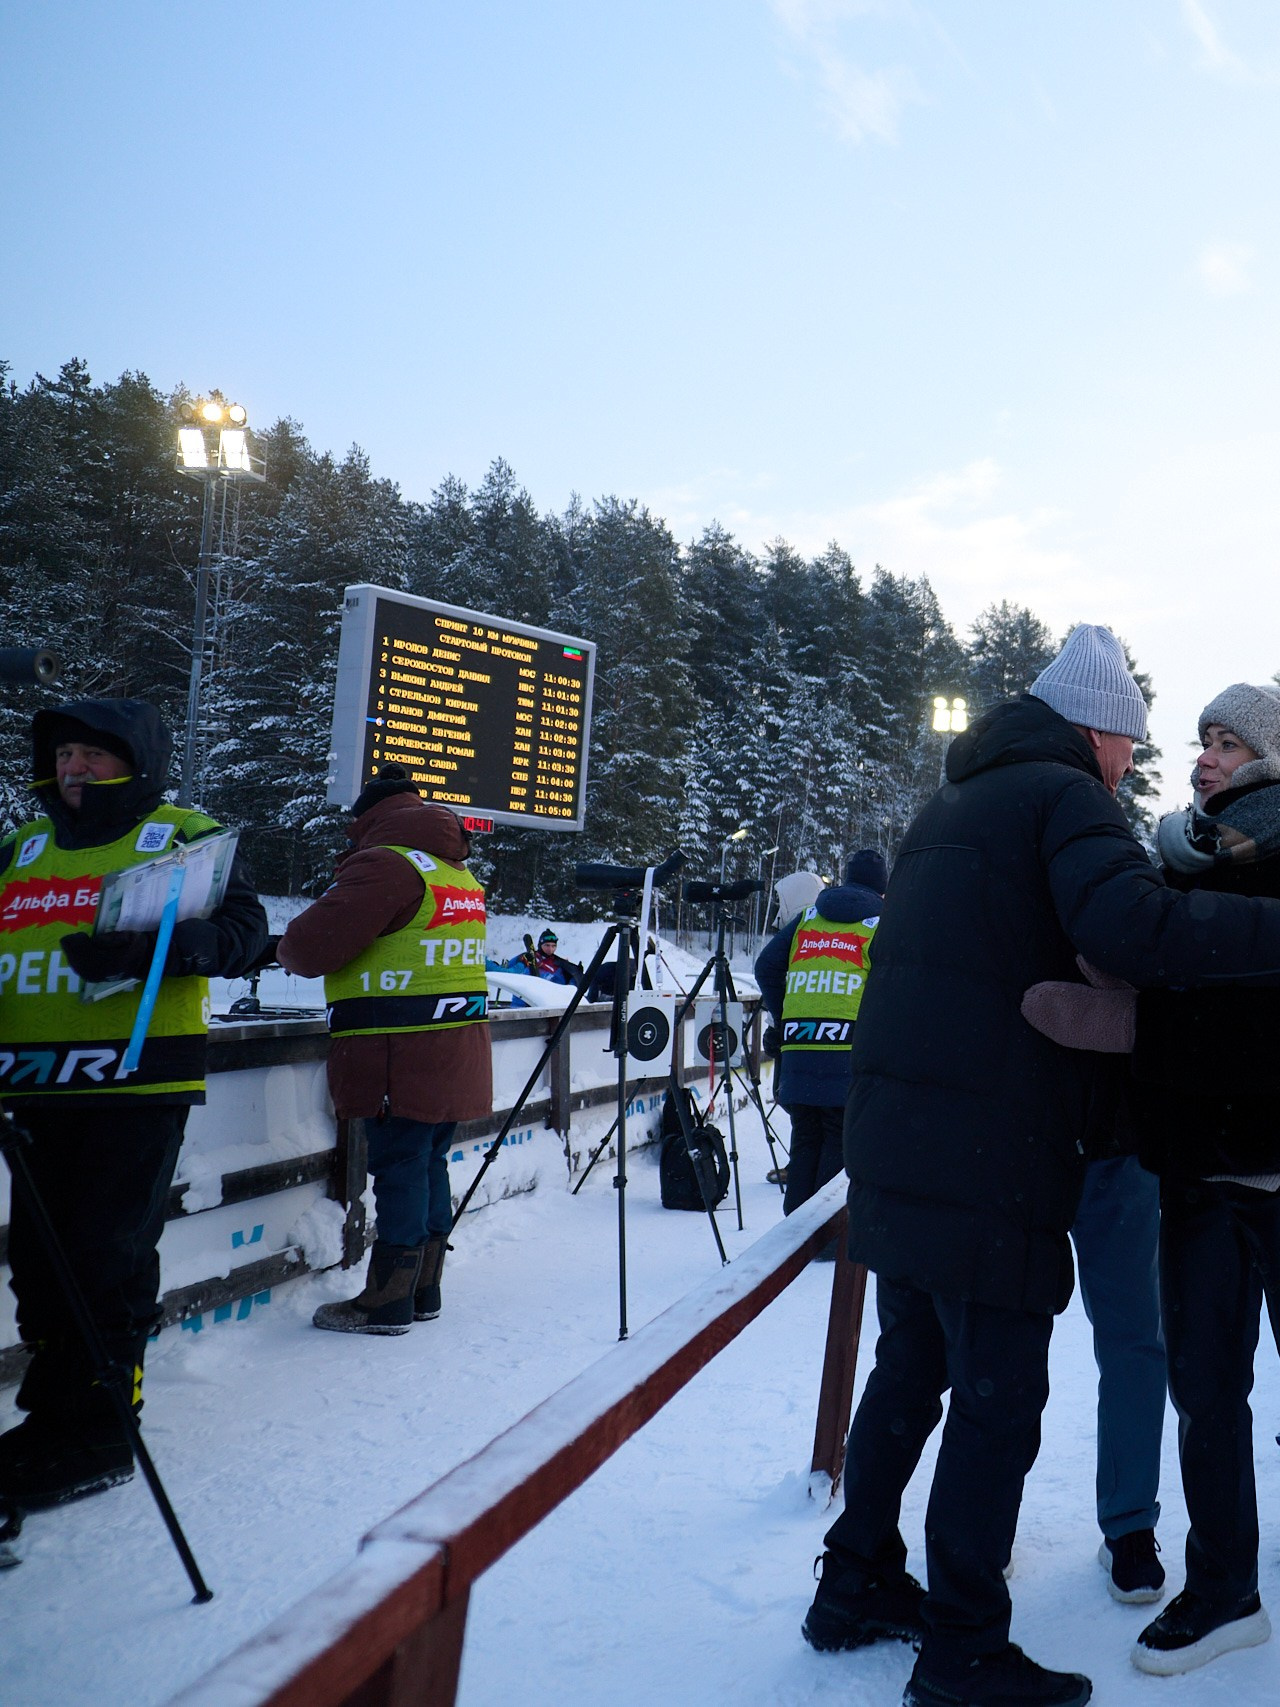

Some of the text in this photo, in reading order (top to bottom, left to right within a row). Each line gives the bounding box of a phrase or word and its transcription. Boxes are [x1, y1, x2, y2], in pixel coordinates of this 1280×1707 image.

[435, 618, 538, 650] СПРИНТ 10 КМ МУЖЧИНЫ
[439, 634, 532, 663] СТАРТОВЫЙ ПРОТОКОЛ
[381, 652, 388, 662] 2
[392, 655, 454, 676] СЕРОХВОСТОВ
[458, 669, 491, 684] ДАНИИЛ
[542, 687, 580, 703] 11:01:00
[383, 636, 581, 689] 1 ИРОДОВ ДЕНИС МОС 11:00:30
[379, 668, 386, 678] 3
[430, 679, 464, 694] АНДРЕЙ
[541, 702, 579, 717] 11:01:30
[379, 684, 578, 732] 4 СТРЕЛЬЦОВ КИРИЛЛ МОС 11:02:00
[375, 717, 576, 760] 6 СМИРНОВ ЕВГЕНИЙ ХАН 11:03:00
[377, 700, 577, 746] 5 ИВАНОВ ДМИТРИЙ ХАН 11:02:30
[373, 749, 574, 789] 8 ТОСЕНКО САВВА СПБ 11:04:00
[374, 733, 575, 775] 7 БОЙЧЕВСКИЙ РОМАН КРК 11:03:30
[371, 765, 573, 803] 9 ДАНИИЛ ПЕР 11:04:30
[432, 790, 471, 804] ЯРОСЛАВ
[509, 801, 526, 812] КРК
[534, 804, 572, 817] 11:05:00
[3, 889, 100, 915] Альфа Ба
[443, 897, 475, 914] Альфа
[419, 938, 486, 966] ТРЕН
[801, 938, 857, 952] Альфа Банк
[360, 970, 413, 991] 1 67
[786, 970, 863, 995] ТРЕНЕР
[783, 1022, 850, 1041] PARI
